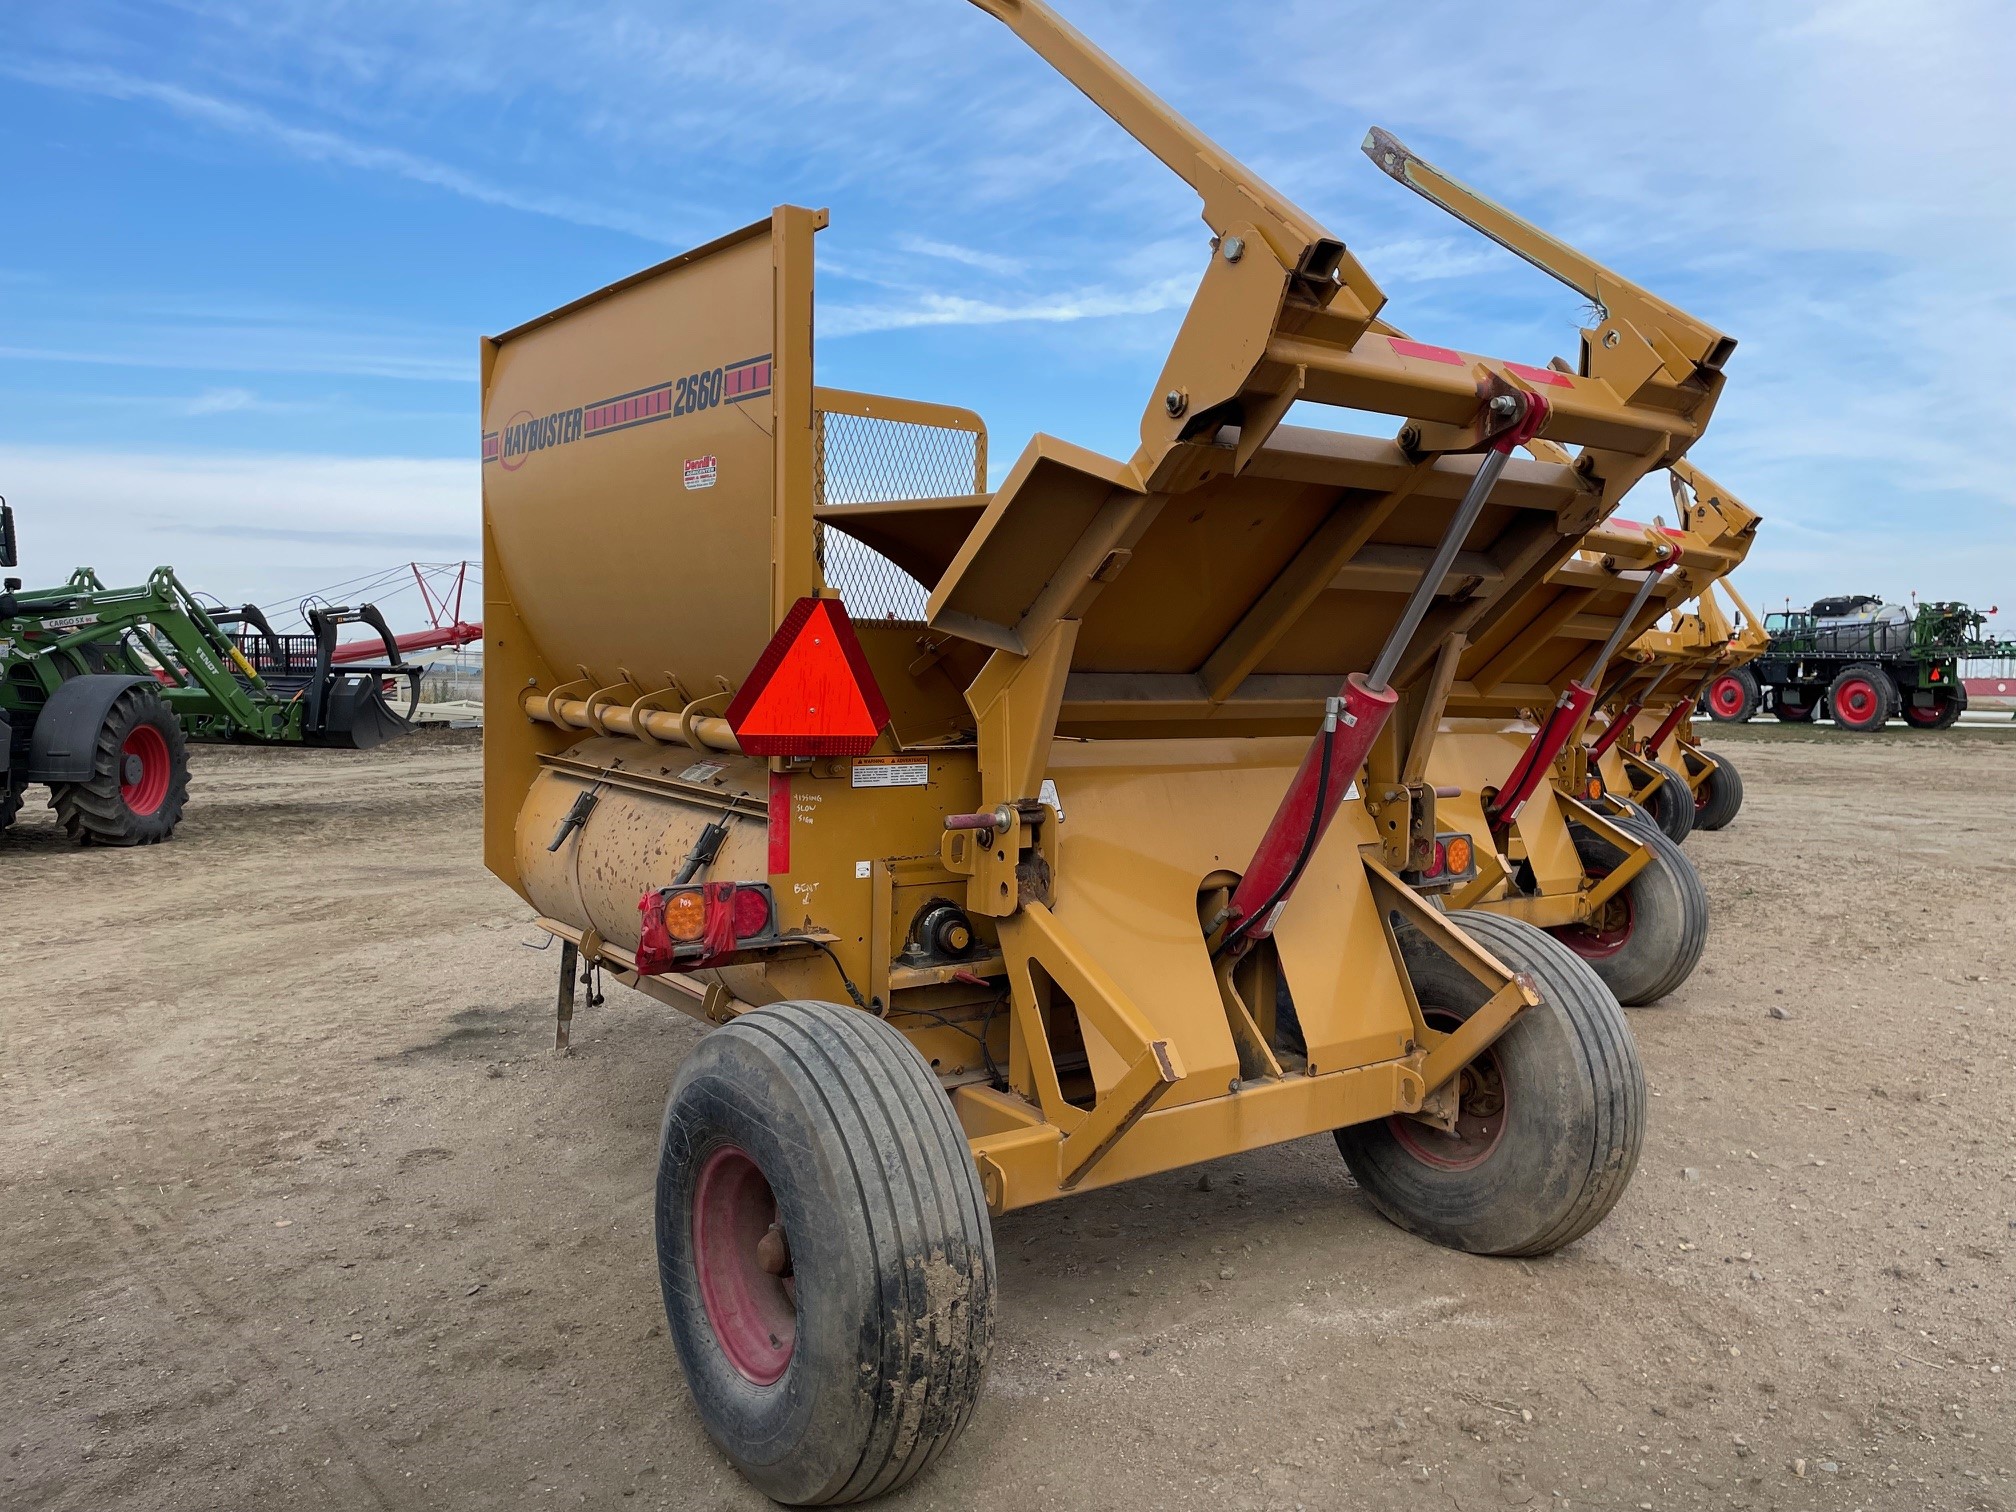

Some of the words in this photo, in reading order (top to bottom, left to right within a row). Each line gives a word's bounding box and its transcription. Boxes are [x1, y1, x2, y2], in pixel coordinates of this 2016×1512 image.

[504, 407, 583, 457] HAYBUSTER
[673, 367, 723, 417] 2660
[50, 619, 74, 627] CARGO
[196, 646, 219, 675] FENDT
[796, 804, 817, 812] SLOW
[798, 814, 814, 825] SIGN
[794, 882, 820, 894] BENT
